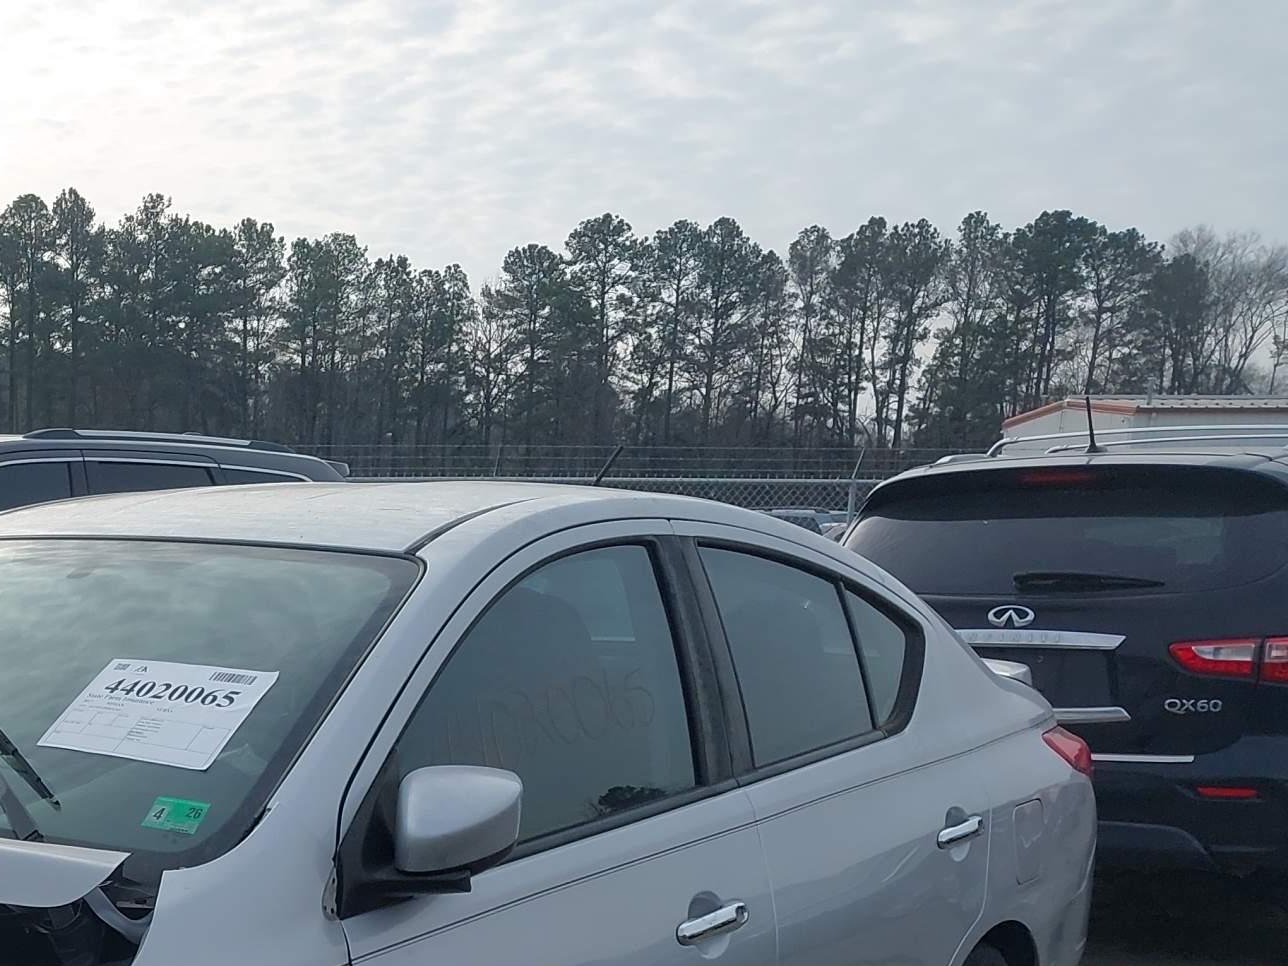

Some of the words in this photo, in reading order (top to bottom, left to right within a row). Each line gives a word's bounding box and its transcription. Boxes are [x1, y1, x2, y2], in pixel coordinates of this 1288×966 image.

[105, 678, 242, 708] 44020065
[1164, 698, 1223, 714] QX60
[153, 807, 166, 821] 4
[185, 807, 203, 819] 26
